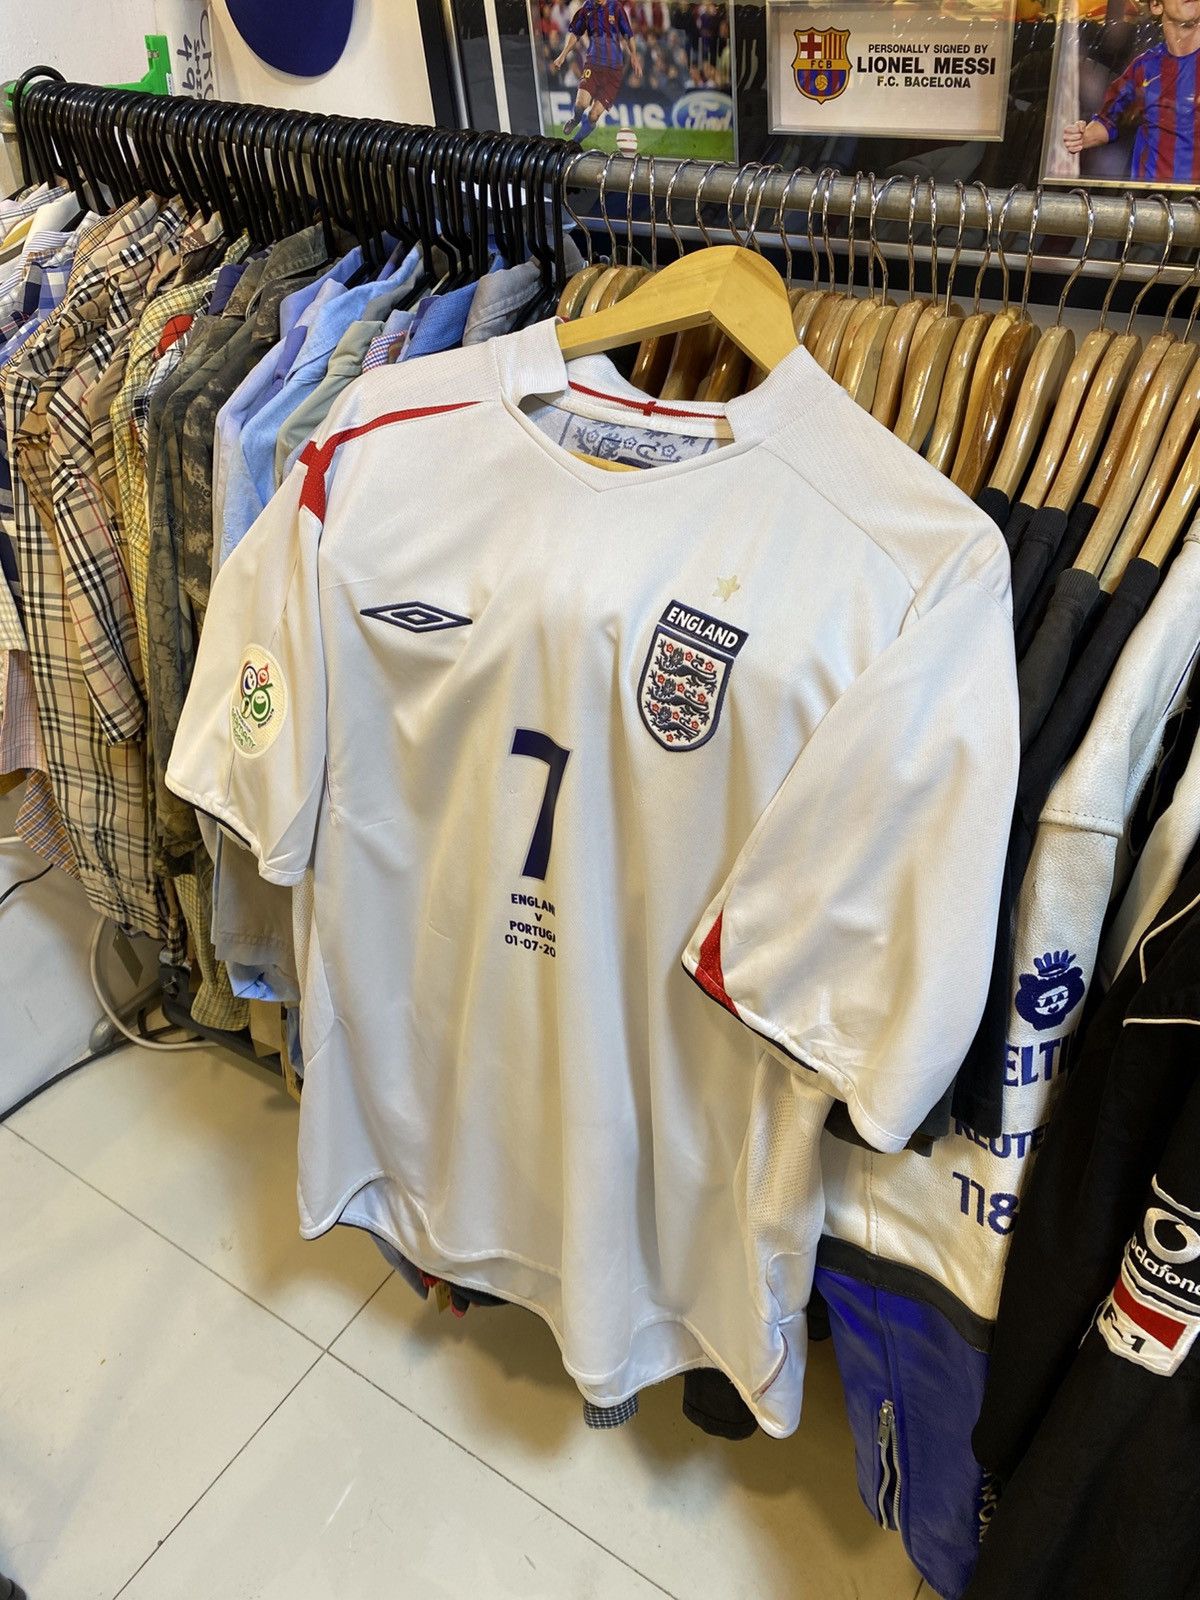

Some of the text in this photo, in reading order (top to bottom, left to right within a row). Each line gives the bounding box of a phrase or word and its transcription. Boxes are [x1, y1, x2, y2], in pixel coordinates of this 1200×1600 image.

[867, 44, 989, 55] PERSONALLY SIGNED BY
[857, 56, 996, 75] LIONEL MESSI
[876, 76, 971, 89] F.C. BACELONA
[550, 91, 667, 130] FCUS
[666, 606, 739, 649] ENGLAND
[509, 727, 572, 882] 7
[511, 893, 556, 917] ENGLAN
